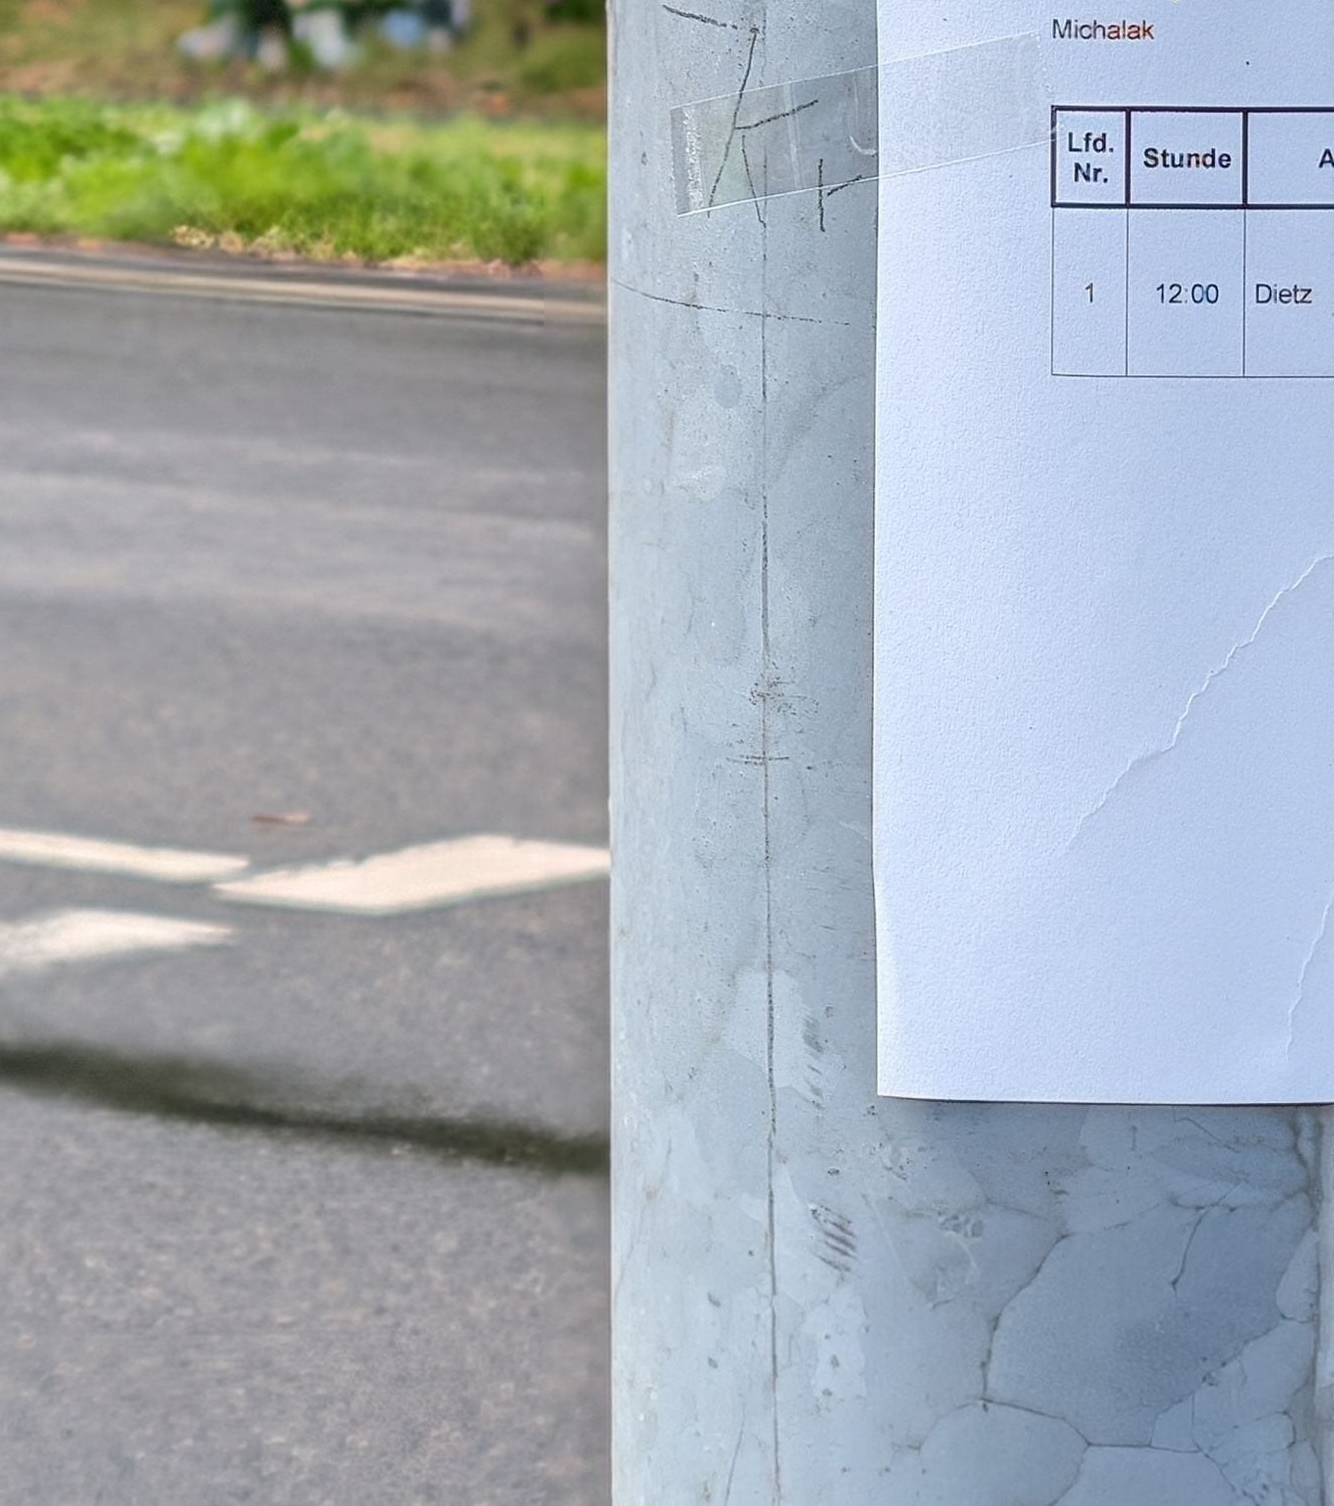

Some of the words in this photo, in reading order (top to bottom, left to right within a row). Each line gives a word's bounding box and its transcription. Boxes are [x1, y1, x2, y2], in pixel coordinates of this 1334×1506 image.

[1052, 19, 1155, 41] Michalak
[1067, 132, 1114, 153] Lfd.
[1143, 148, 1232, 169] Stunde
[1073, 162, 1109, 184] Nr.
[1085, 283, 1095, 303] 1
[1255, 283, 1313, 304] Dietz
